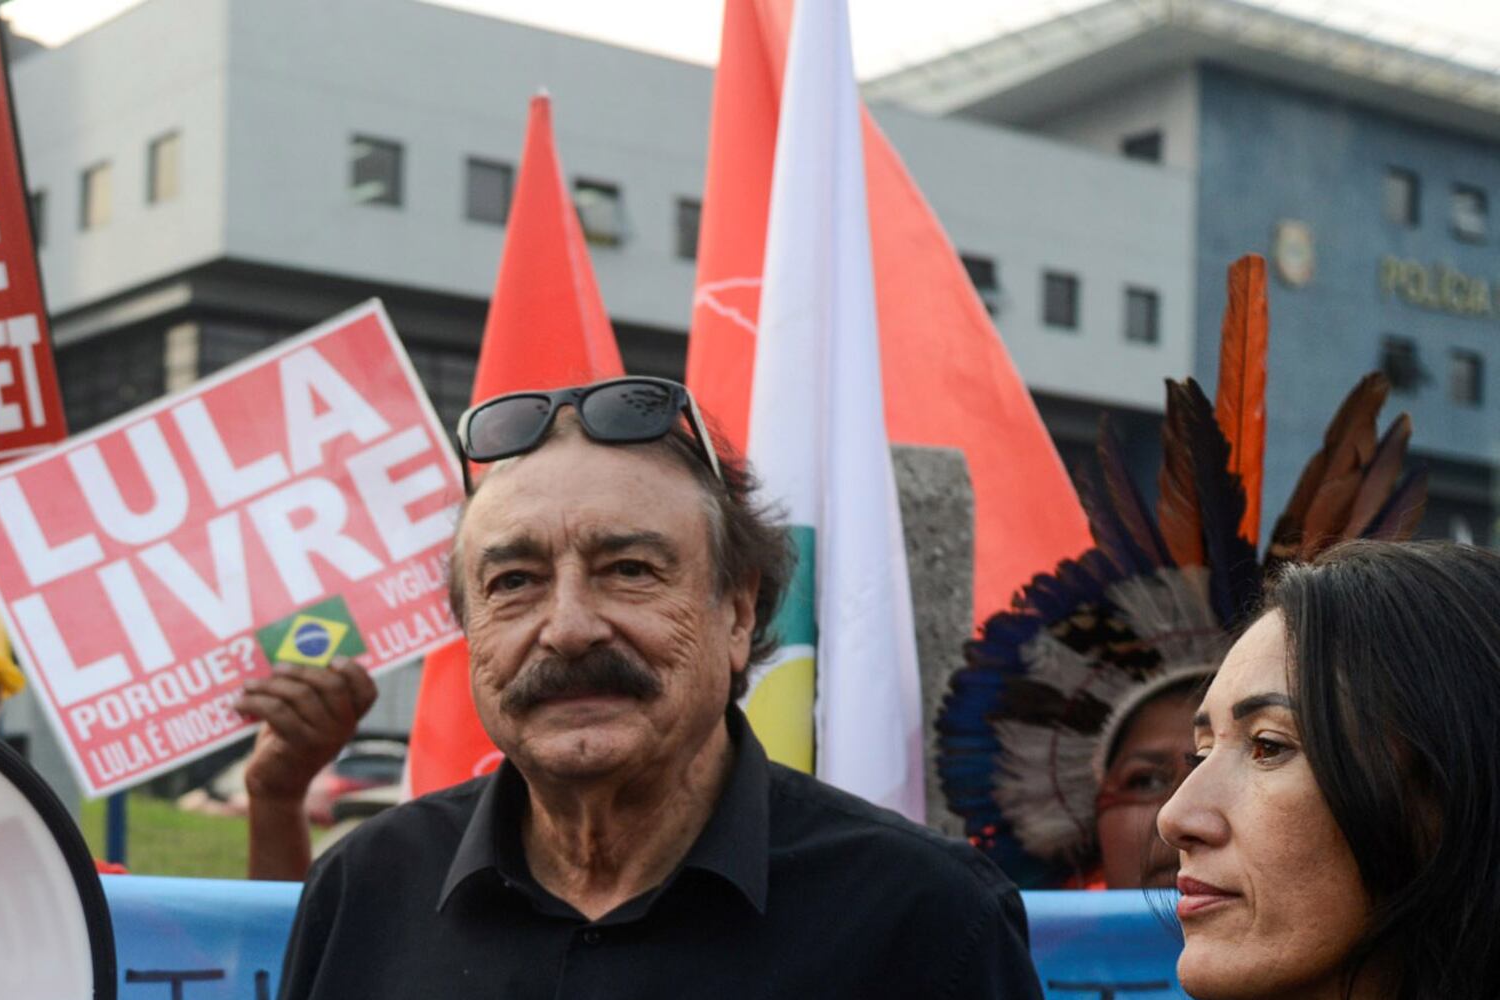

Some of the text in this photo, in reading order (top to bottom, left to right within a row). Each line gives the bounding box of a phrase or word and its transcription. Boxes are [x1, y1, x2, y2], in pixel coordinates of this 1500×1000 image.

[12, 425, 461, 708] LIVRE
[375, 550, 450, 608] VIGÍLI
[369, 611, 436, 659] LULA
[70, 636, 256, 741] PORQUE?
[90, 733, 152, 782] LULA
[145, 719, 170, 759] É
